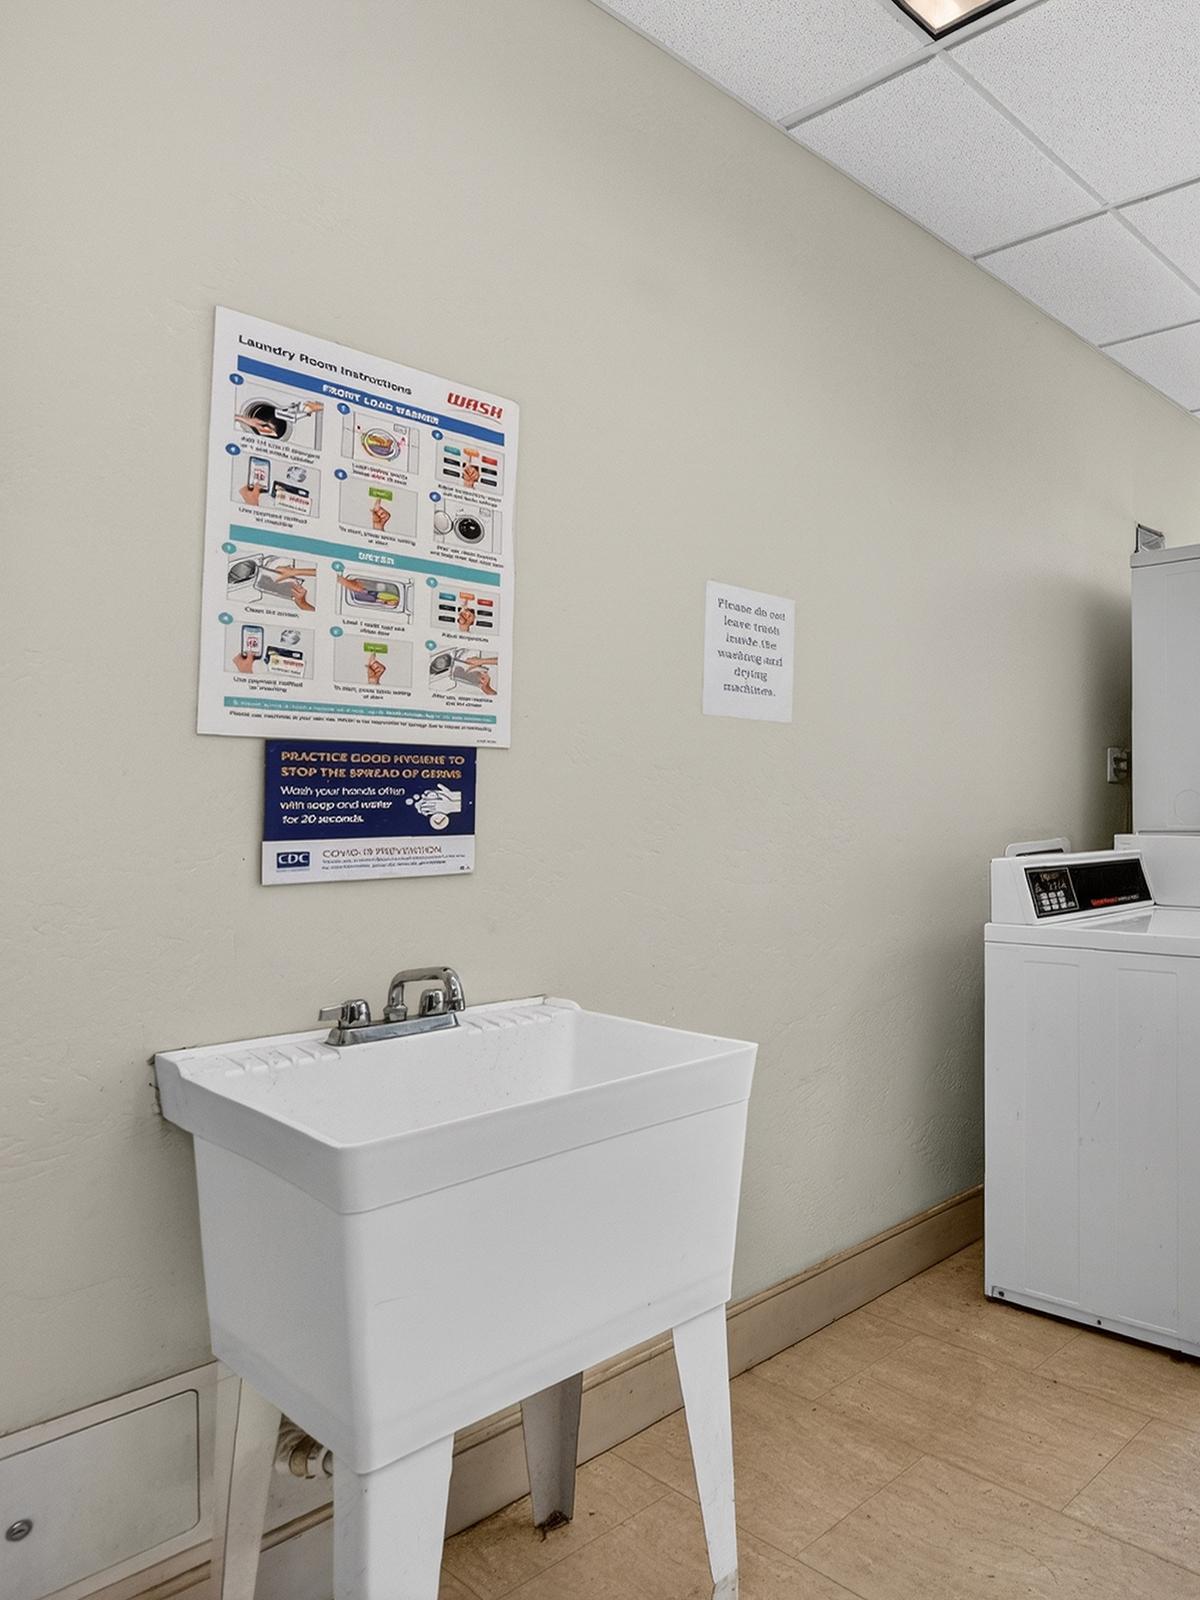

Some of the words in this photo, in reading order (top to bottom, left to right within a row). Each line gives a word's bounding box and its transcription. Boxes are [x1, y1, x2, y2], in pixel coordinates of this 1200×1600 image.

[238, 334, 296, 361] Laundry
[299, 352, 338, 374] Room
[340, 364, 413, 396] Instructions
[321, 383, 362, 402] FRONT
[363, 396, 394, 412] LOAD
[447, 391, 504, 420] WASH
[357, 551, 396, 566] DRYER
[717, 597, 753, 616] Please
[754, 606, 768, 618] do
[769, 611, 786, 621] not
[723, 615, 752, 631] leave
[725, 632, 759, 647] inside
[759, 640, 777, 651] the
[717, 649, 763, 666] washing
[763, 656, 784, 668] and
[733, 666, 769, 683] drying
[280, 750, 349, 763] PRACTICE
[350, 752, 392, 765] GOOD
[393, 753, 446, 766] HYGIENE
[448, 755, 466, 766] TO
[280, 766, 318, 778] STOP
[319, 767, 347, 778] THE
[349, 768, 401, 779] SPREAD
[401, 768, 420, 779] OF
[420, 769, 463, 780] GERMS
[279, 785, 314, 796] Wash
[314, 786, 340, 799] your
[341, 785, 377, 796] hands
[377, 785, 406, 796] often
[279, 800, 305, 811] with
[306, 800, 335, 813] soap
[335, 800, 360, 810] and
[360, 800, 393, 810] water
[281, 815, 299, 825] for
[300, 814, 317, 825] 20
[317, 814, 365, 825] seconds.
[277, 852, 311, 865] CDC
[322, 848, 375, 859] COVID-19
[375, 845, 443, 858] PREVENTION
